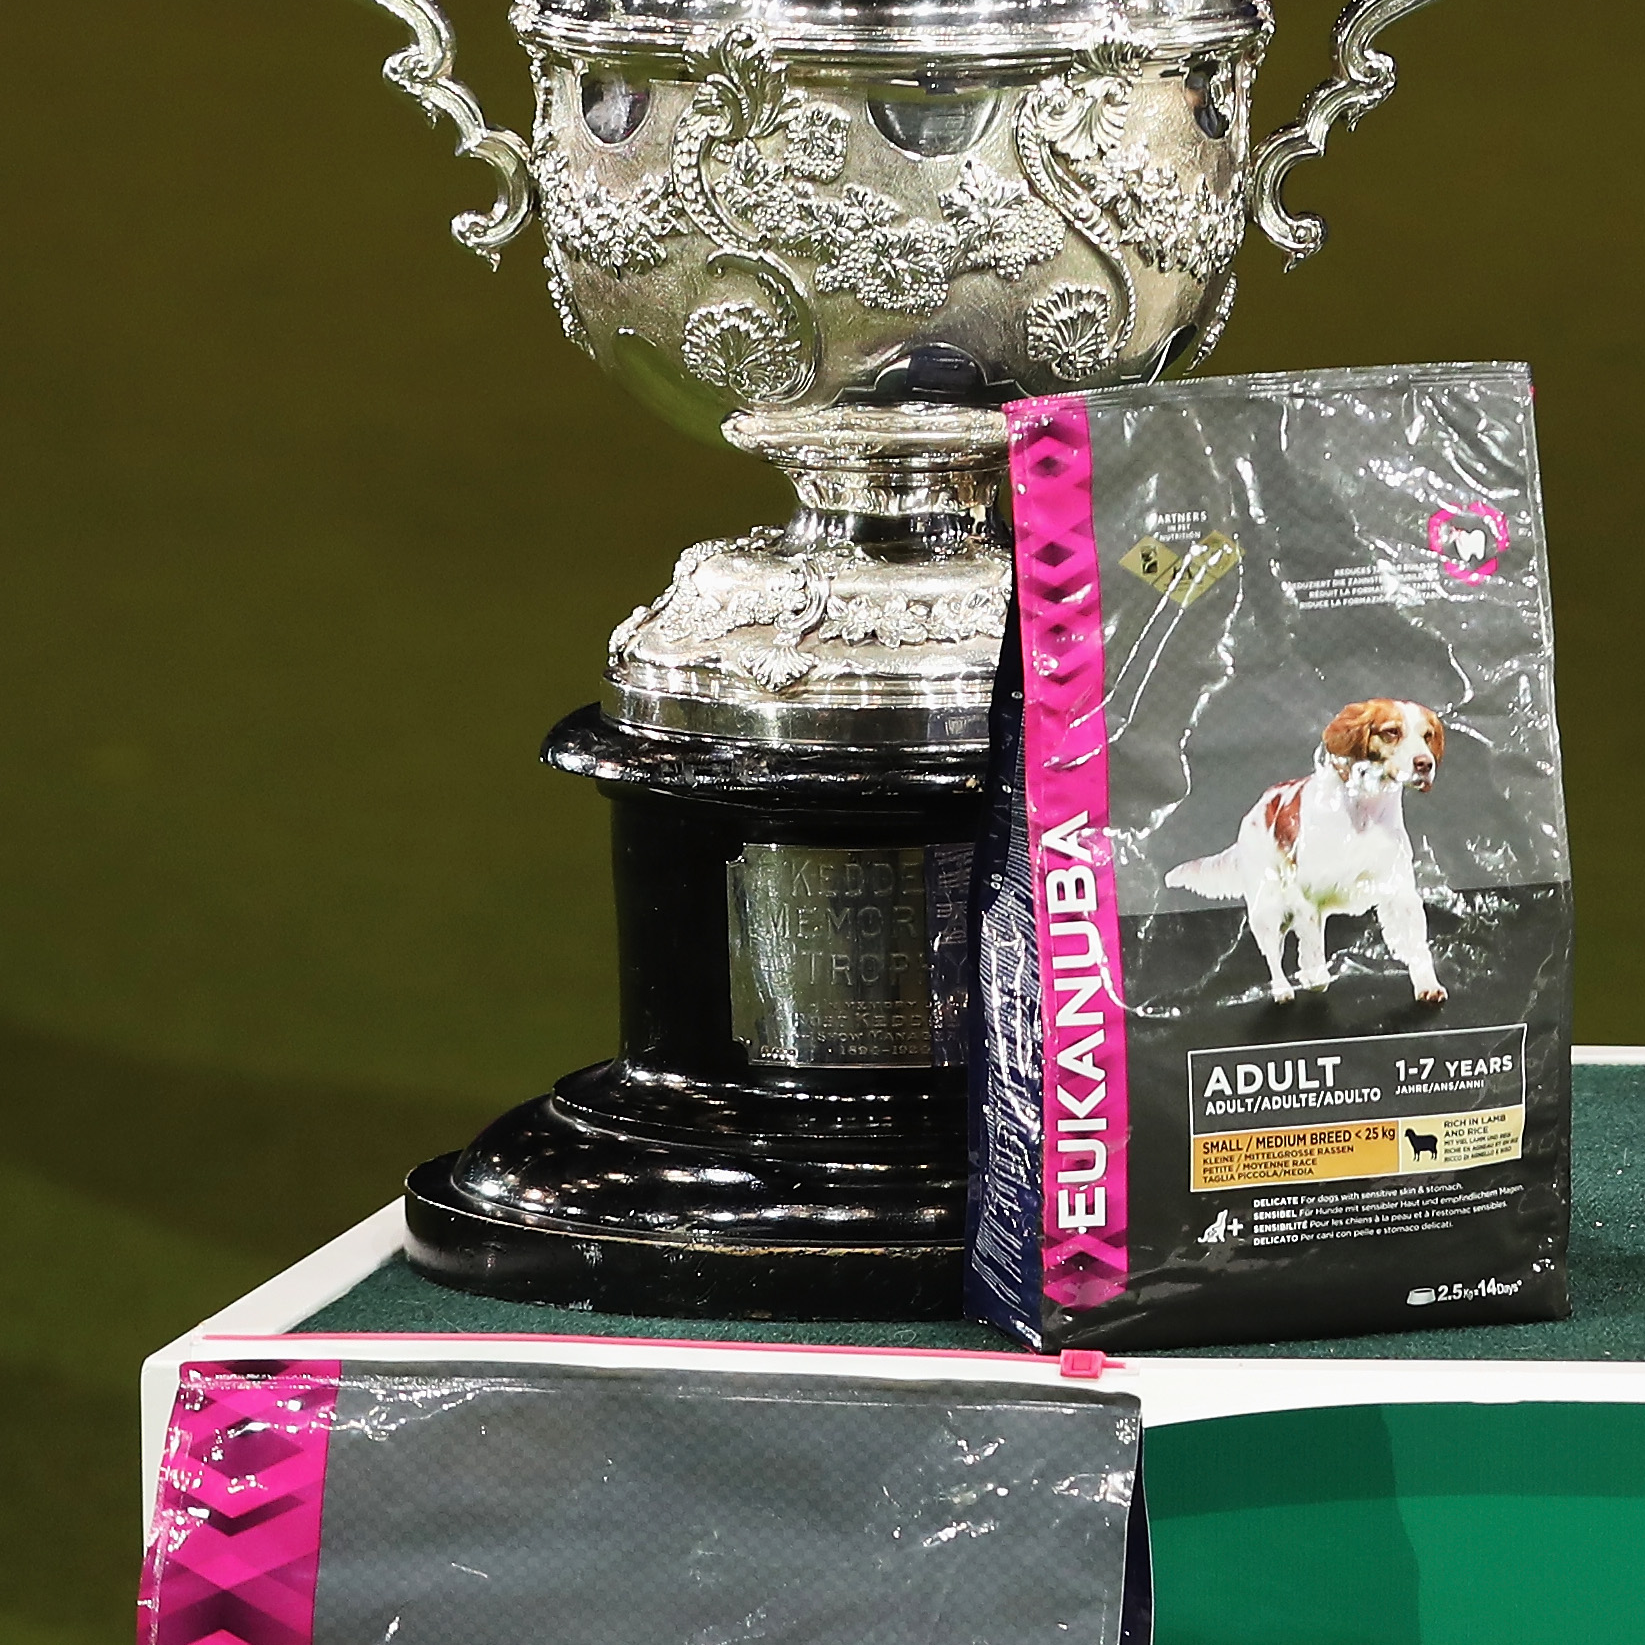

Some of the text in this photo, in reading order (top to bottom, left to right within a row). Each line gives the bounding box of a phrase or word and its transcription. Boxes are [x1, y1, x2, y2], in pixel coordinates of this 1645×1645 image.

[1150, 510, 1208, 524] ARTNERS
[1042, 810, 1108, 1230] EUKANUBA
[1203, 1055, 1513, 1098] ADULT 1-7 YEARS
[1395, 1079, 1485, 1095] JAHRE/ANS/ANNI
[1205, 1087, 1382, 1116] ADULT/ADULTE/ADULTO
[1444, 1114, 1506, 1128] RICH IN LAMB
[1444, 1126, 1489, 1138] AND RICE
[1203, 1138, 1243, 1155] SMALL
[1256, 1133, 1307, 1149] MEDIUM
[1310, 1129, 1352, 1145] BREED
[1365, 1127, 1379, 1140] 25
[1381, 1126, 1396, 1141] kg
[1203, 1156, 1235, 1165] KLEINE
[1244, 1147, 1315, 1161] MITTELGROSSE
[1317, 1144, 1354, 1156] RASSEN
[1203, 1165, 1234, 1175] PETITE
[1243, 1160, 1290, 1171] MOYENNE
[1292, 1158, 1317, 1168] RACE
[1203, 1167, 1314, 1184] TAGLIA PICCOLA/MEDIA
[1253, 1196, 1299, 1208] DELICATE
[1300, 1195, 1316, 1204] For
[1317, 1194, 1339, 1205] dogs
[1341, 1191, 1360, 1201] with
[1361, 1188, 1398, 1199] sensitive
[1400, 1185, 1416, 1196] skin
[1253, 1209, 1298, 1221] SENSIBEL
[1315, 1205, 1343, 1215] Hunde
[1345, 1204, 1359, 1213] mit
[1361, 1201, 1398, 1212] sensibler
[1400, 1199, 1420, 1209] Haut
[1421, 1197, 1438, 1206] und
[1253, 1220, 1308, 1233] SENSIBILITÉ
[1310, 1220, 1330, 1229] Pour
[1345, 1216, 1373, 1226] chiens
[1391, 1212, 1412, 1224] peau
[1413, 1210, 1423, 1219] et
[1253, 1234, 1299, 1246] DELICATO
[1300, 1233, 1315, 1242] Per
[1316, 1231, 1334, 1240] cani
[1336, 1230, 1352, 1238] con
[1354, 1227, 1375, 1238] pelle
[1383, 1222, 1420, 1234] stomaco
